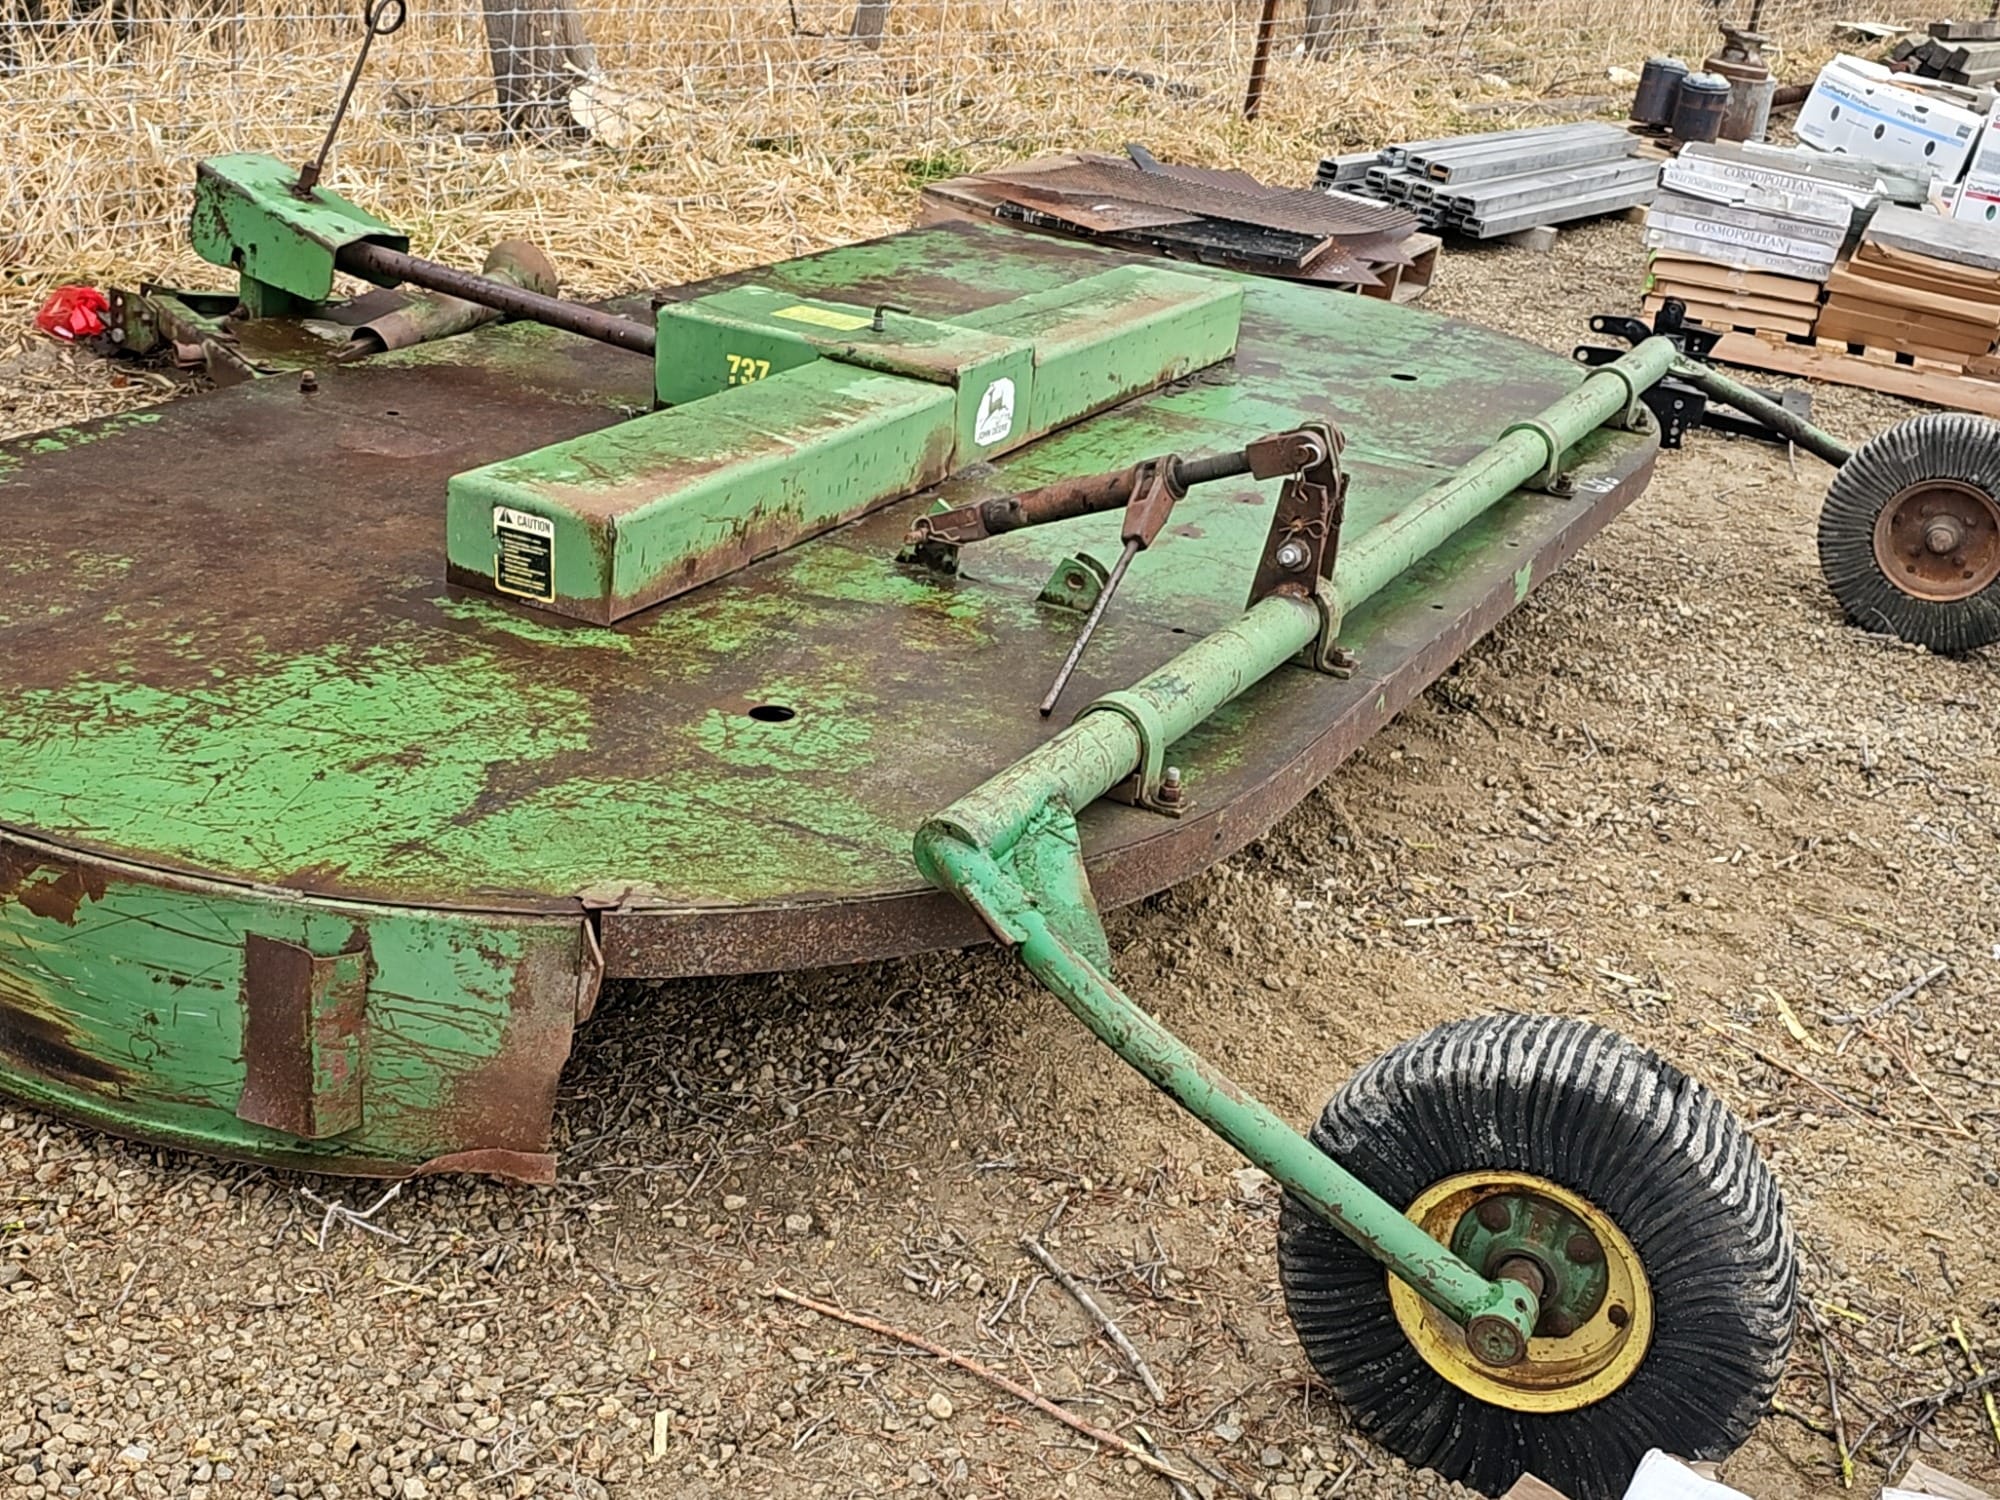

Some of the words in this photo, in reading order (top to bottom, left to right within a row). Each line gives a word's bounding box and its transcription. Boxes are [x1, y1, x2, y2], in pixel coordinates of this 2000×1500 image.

[1724, 167, 1814, 193] COSMOPOLITAN
[1694, 222, 1786, 249] COSMOPOLITAN
[726, 353, 770, 385] 737
[516, 515, 551, 534] CAUTION
